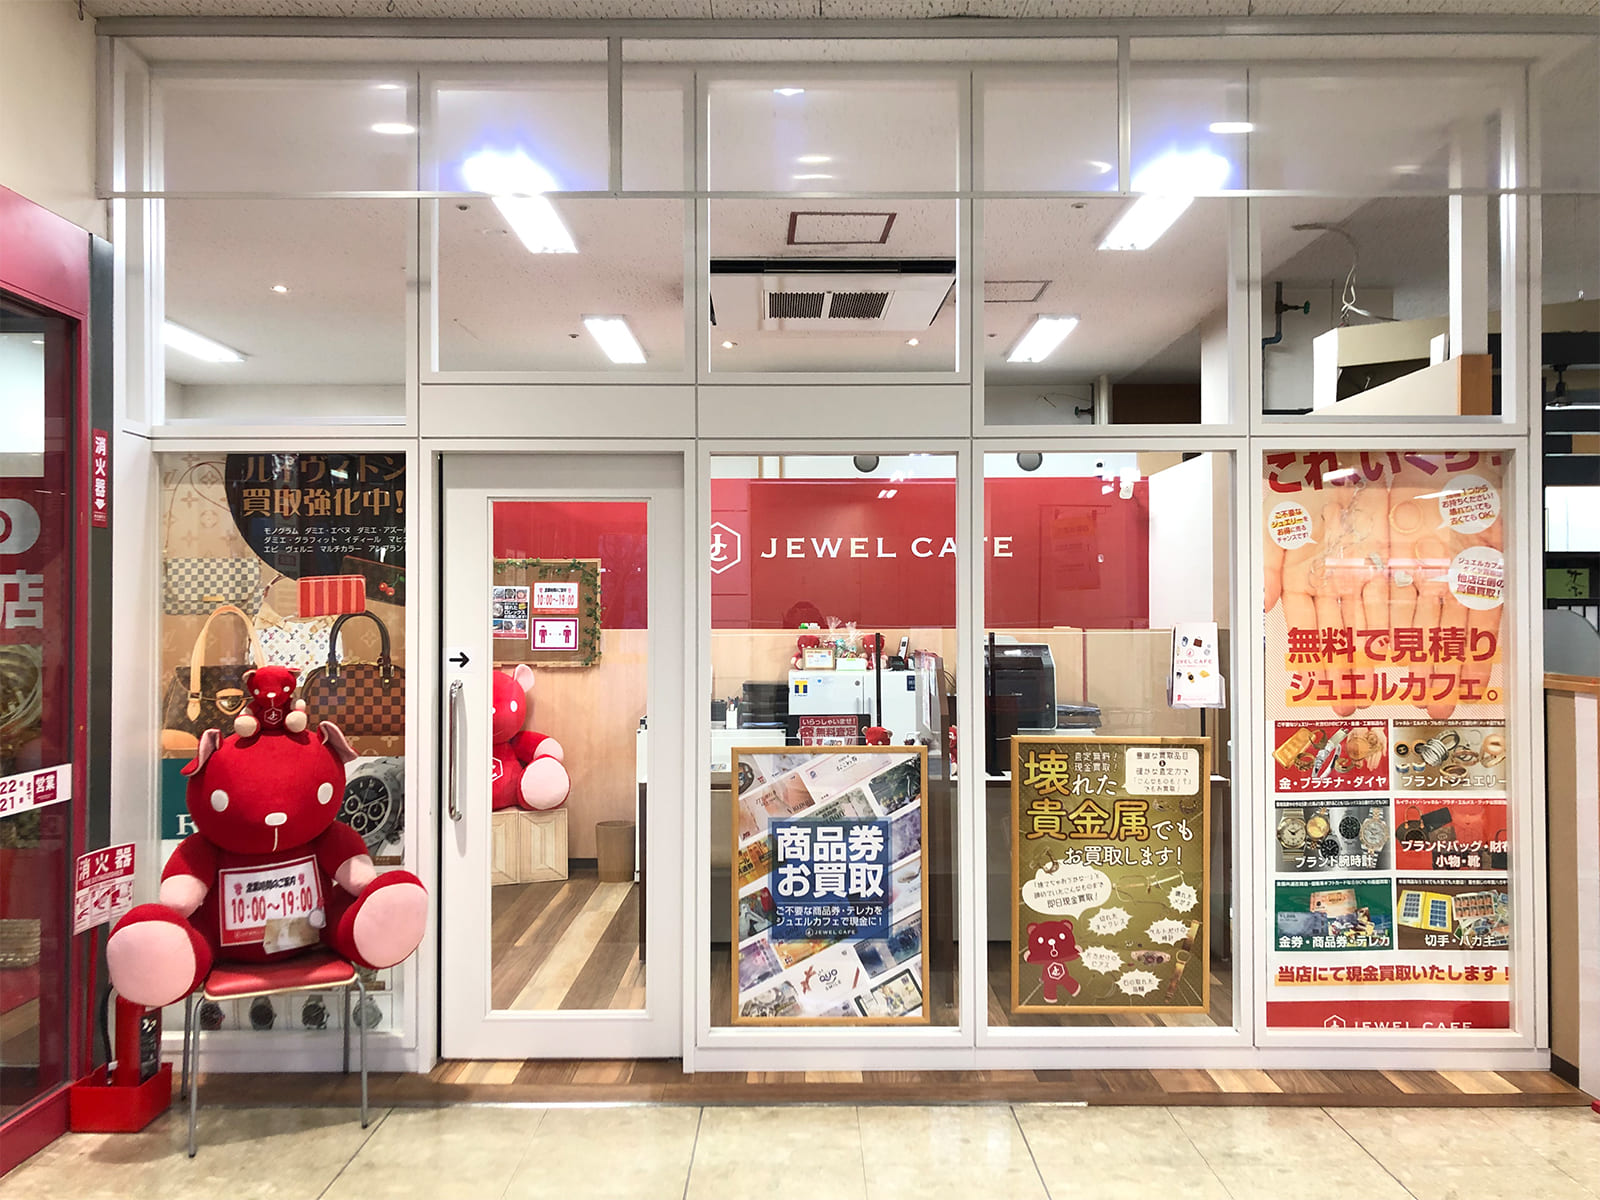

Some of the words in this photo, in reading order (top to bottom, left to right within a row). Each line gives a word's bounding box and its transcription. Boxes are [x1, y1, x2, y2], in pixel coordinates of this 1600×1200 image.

[95, 436, 106, 498] 消火器
[242, 487, 404, 517] 買取強化中!
[264, 527, 299, 535] モノグラム
[357, 527, 406, 535] ダミエ・アズー
[285, 545, 314, 553] ヴェルニ
[320, 545, 362, 553] マルチカラー
[760, 537, 897, 558] JEWEL
[911, 536, 1013, 558] CAE
[1288, 627, 1498, 664] 無料で見積り
[1290, 671, 1499, 701] ジュエルカフェ。
[1023, 749, 1118, 796] 壊れた
[1026, 797, 1193, 841] 貴金属でも
[775, 825, 885, 864] 商品券
[1064, 846, 1182, 866] お買取します!
[79, 846, 133, 881] 消火器
[1436, 854, 1481, 868] 小物・靴
[778, 863, 885, 900] お買取
[231, 886, 313, 924] 10:00～19:00
[776, 906, 883, 916] ご不要な商品券・テレカを
[776, 917, 883, 926] ジュエルカフェで現金に!
[1278, 965, 1510, 982] 当店にて現金買取いたします!
